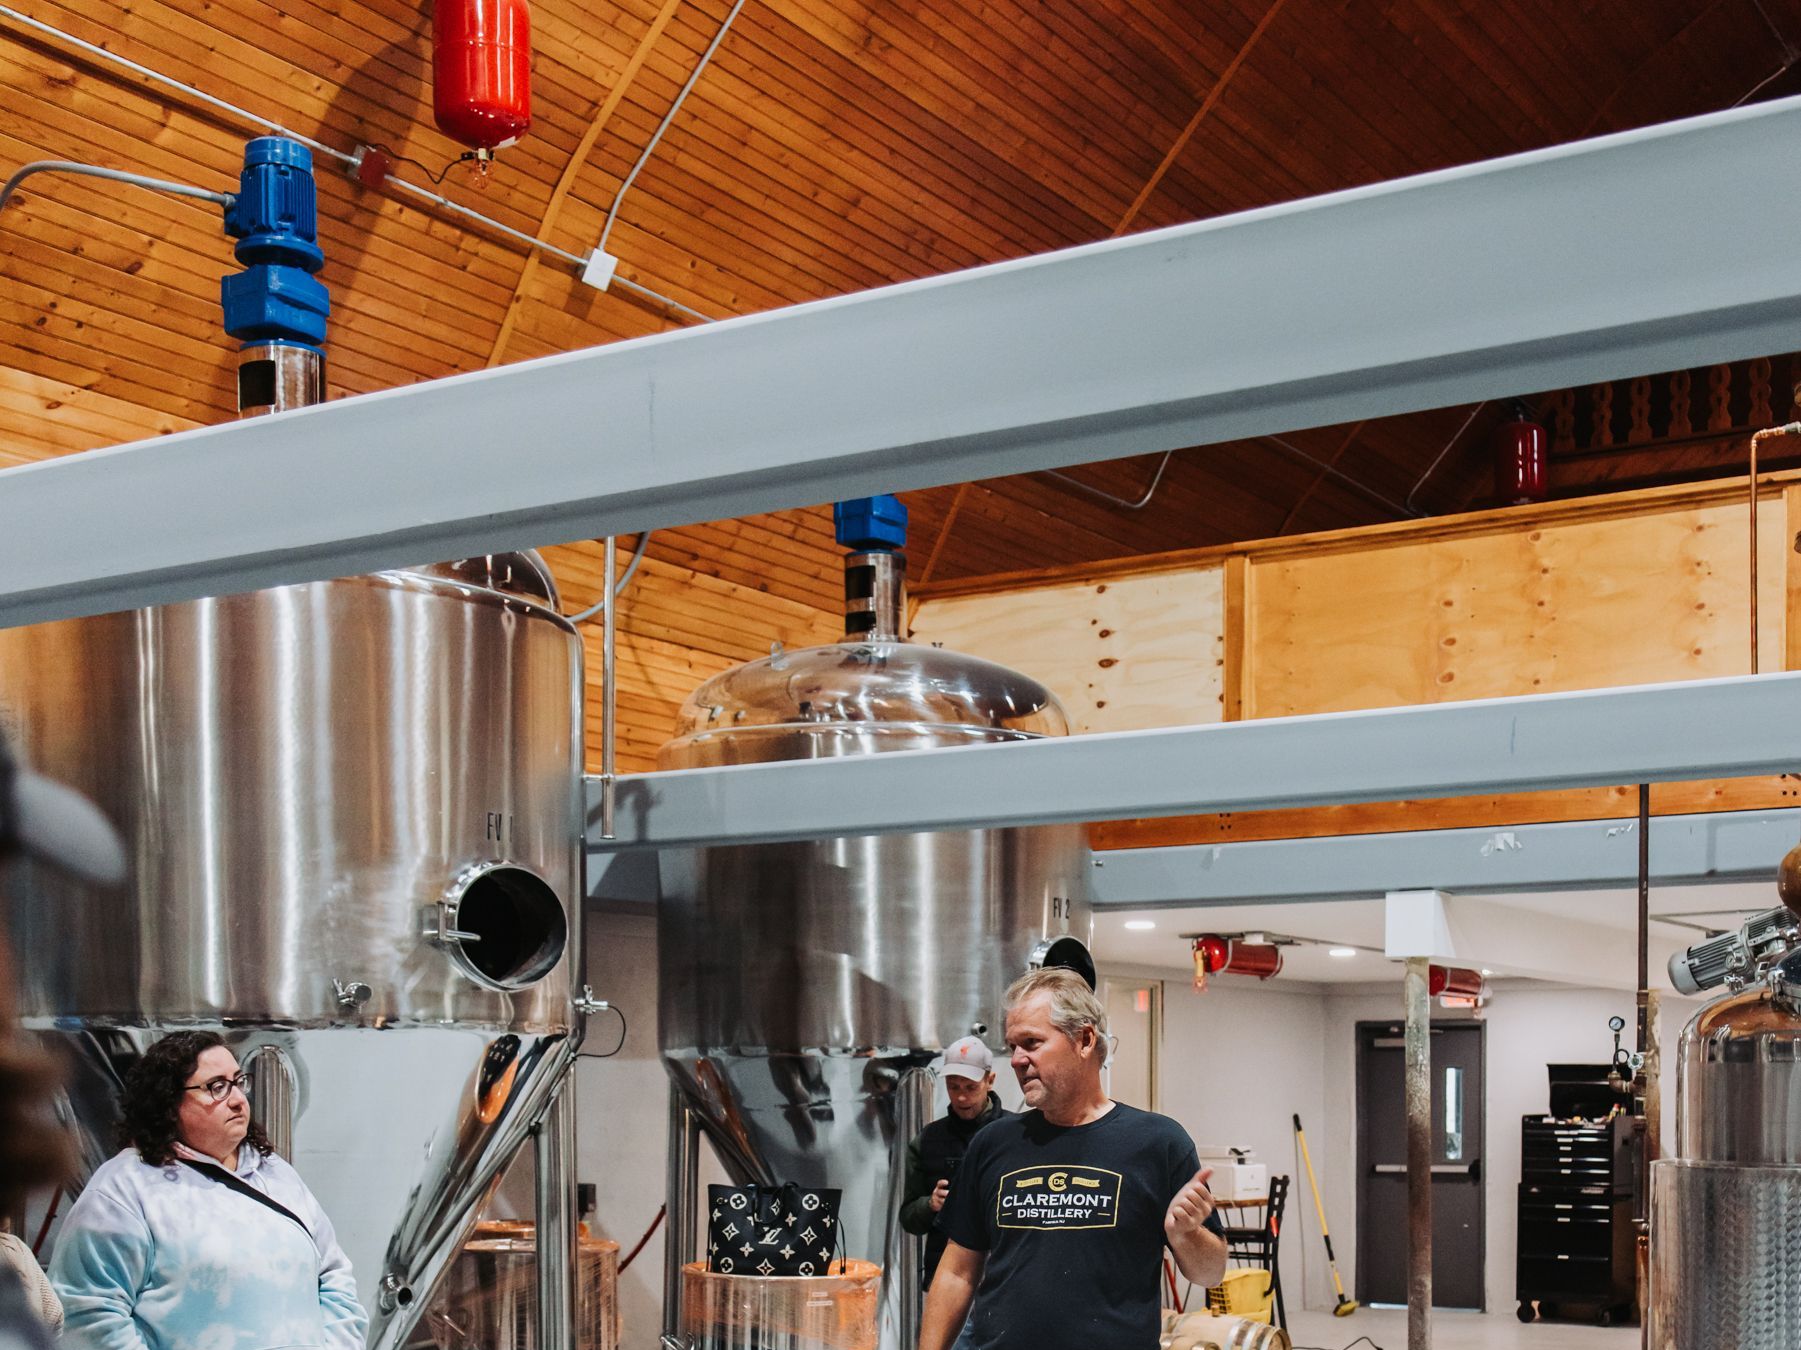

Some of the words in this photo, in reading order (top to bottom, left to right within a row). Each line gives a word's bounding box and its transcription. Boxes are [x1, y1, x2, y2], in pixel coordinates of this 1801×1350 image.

[487, 812, 502, 841] FV
[1002, 1194, 1112, 1208] CLAREMONT
[1017, 1208, 1093, 1219] DISTILLERY
